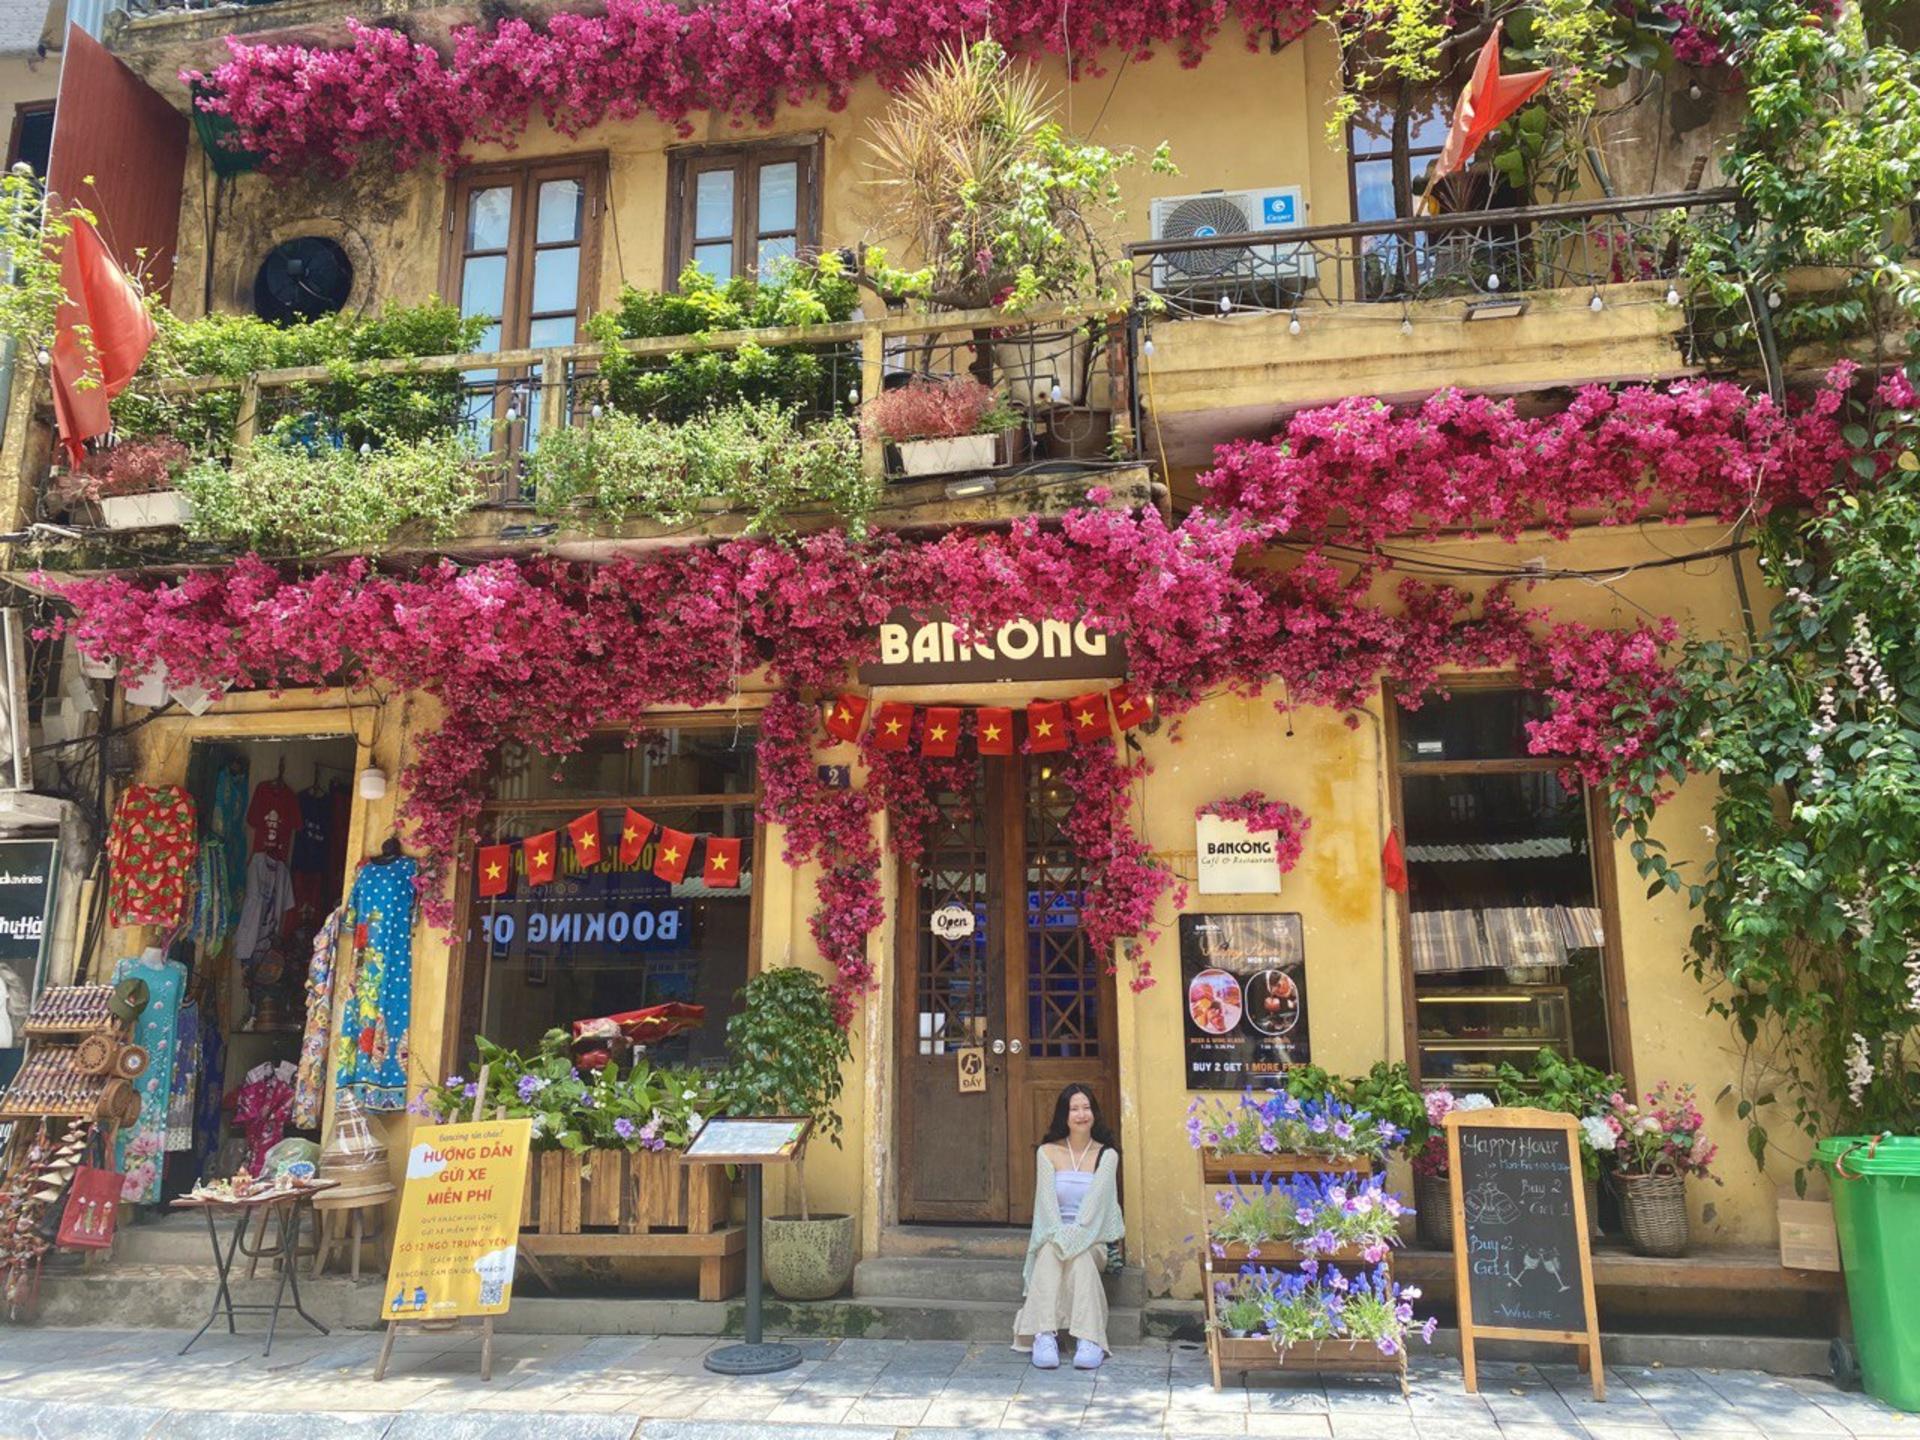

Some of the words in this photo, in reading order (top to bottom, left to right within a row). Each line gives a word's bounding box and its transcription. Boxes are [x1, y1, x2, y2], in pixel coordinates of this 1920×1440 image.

[828, 768, 840, 785] 2
[937, 914, 967, 931] Open
[1193, 1062, 1212, 1071] BUY
[1214, 1062, 1221, 1072] 2
[1223, 1062, 1242, 1071] GET
[1251, 1062, 1279, 1071] MORE
[424, 1145, 476, 1162] HƯỚNG
[480, 1141, 513, 1159] DẪN
[1461, 1134, 1516, 1158] Happy
[1519, 1136, 1559, 1158] Hour
[467, 1168, 487, 1180] XE
[466, 1185, 493, 1202] PHÍ
[1520, 1179, 1546, 1199] Buy
[1551, 1178, 1562, 1193] 2
[1529, 1201, 1554, 1215] Get
[1561, 1201, 1571, 1216] 1
[452, 1238, 486, 1249] TRUNG
[1469, 1234, 1499, 1260] Buy
[1500, 1235, 1514, 1250] 2
[1473, 1260, 1499, 1276] Get
